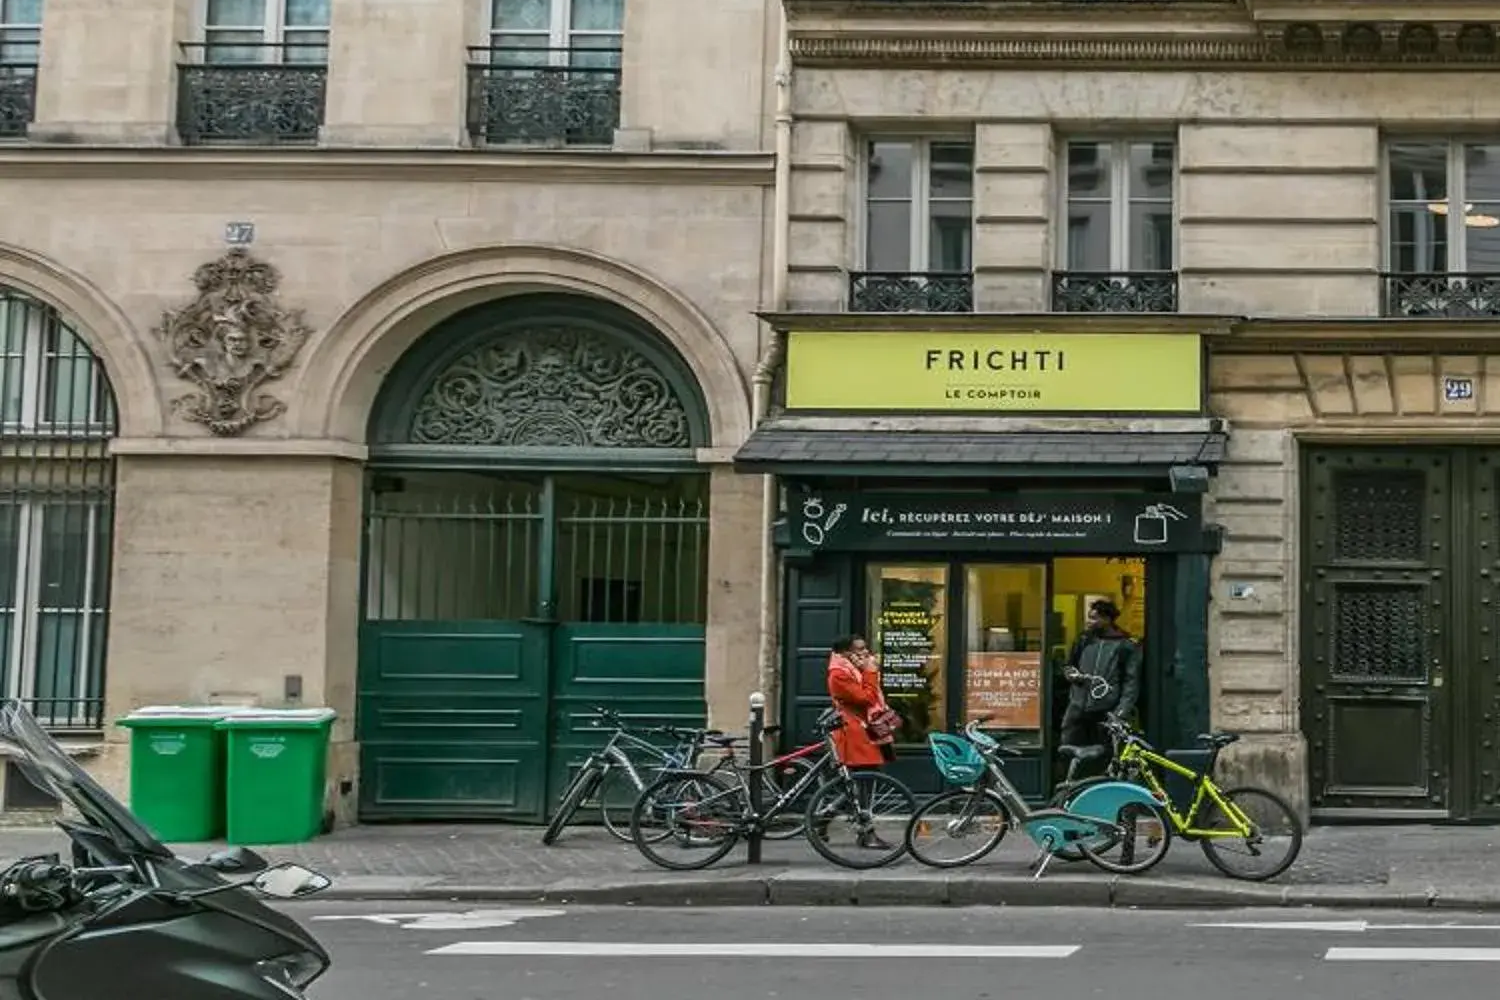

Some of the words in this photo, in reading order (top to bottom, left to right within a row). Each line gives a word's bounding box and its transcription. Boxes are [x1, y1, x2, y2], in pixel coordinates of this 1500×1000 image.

[226, 225, 252, 241] 27
[926, 350, 1064, 371] FRICHTI
[945, 389, 961, 399] LE
[967, 389, 1041, 399] COMPTOIR
[1447, 381, 1471, 397] 29
[974, 512, 1015, 523] VOTRE
[1051, 513, 1101, 523] MAISON
